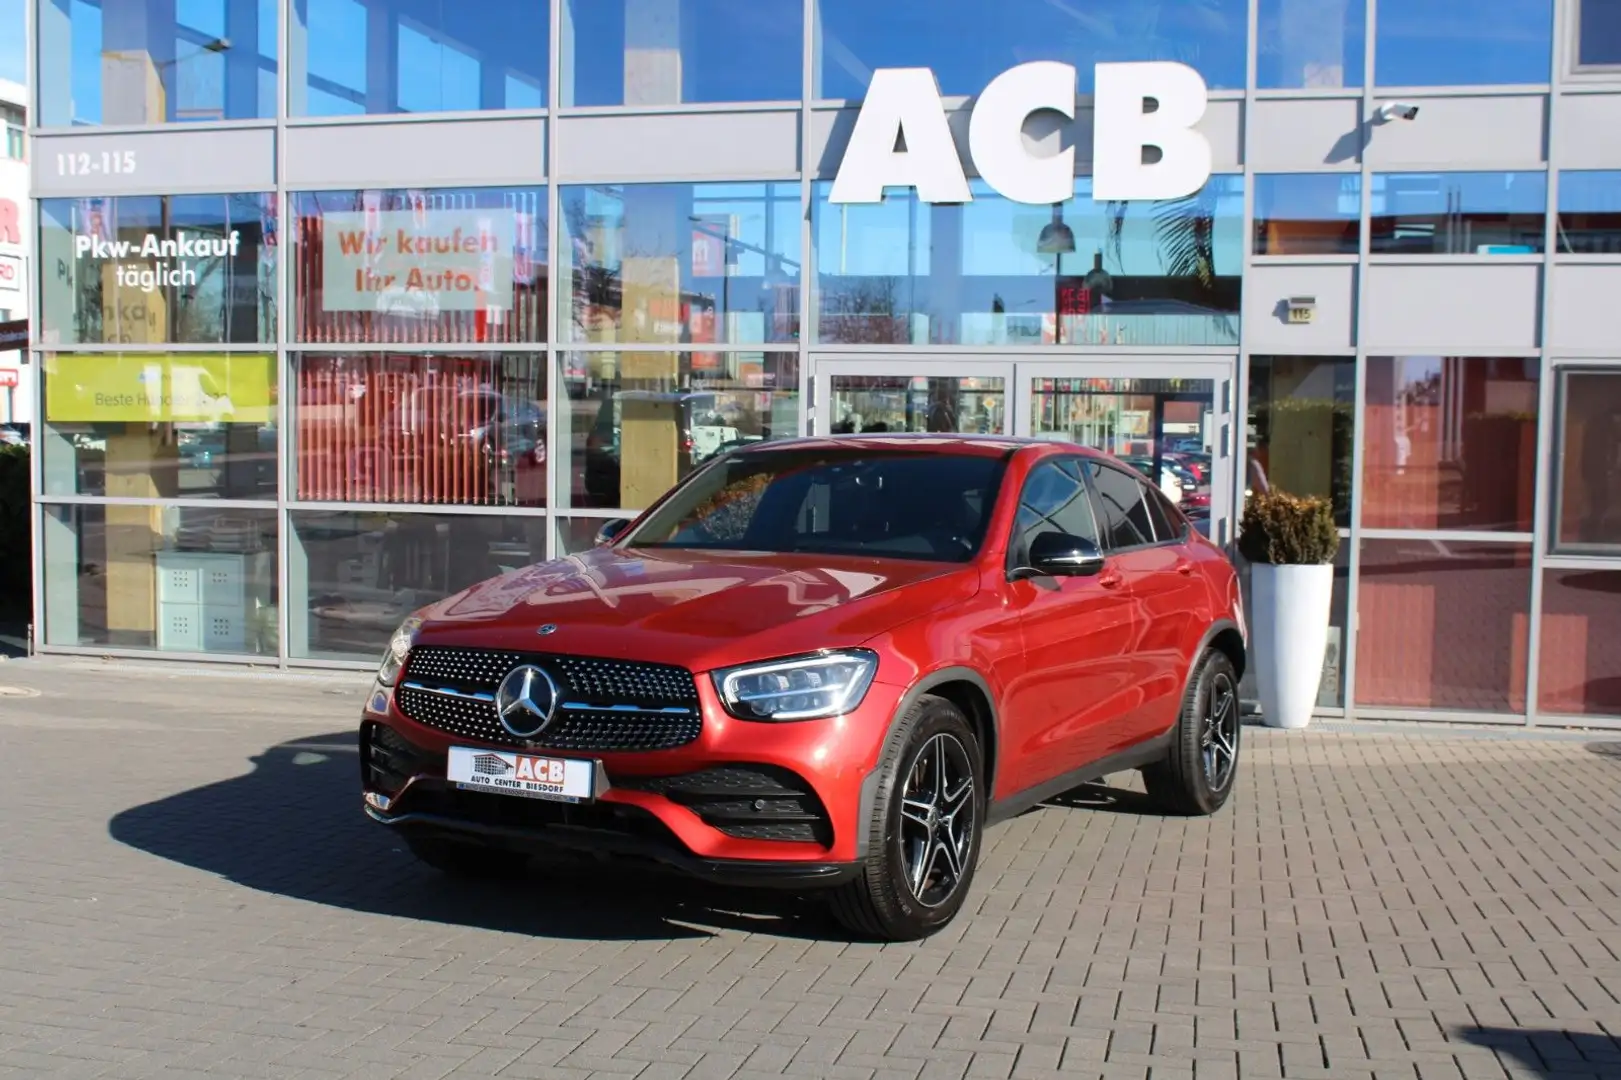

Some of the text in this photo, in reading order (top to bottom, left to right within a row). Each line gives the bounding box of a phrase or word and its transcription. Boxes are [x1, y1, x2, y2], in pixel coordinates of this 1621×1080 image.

[828, 61, 1212, 204] ACB
[57, 151, 136, 176] 112-115
[76, 231, 240, 258] Pkw-Ankauf
[338, 226, 498, 255] Wir kaufen
[117, 262, 196, 292] täglich
[355, 267, 479, 292] Ihr Auto.
[95, 392, 133, 407] Beste
[517, 757, 564, 782] ACB
[471, 776, 490, 784] AUTO
[494, 778, 521, 789] CENTER
[526, 782, 564, 793] BIESDORF
